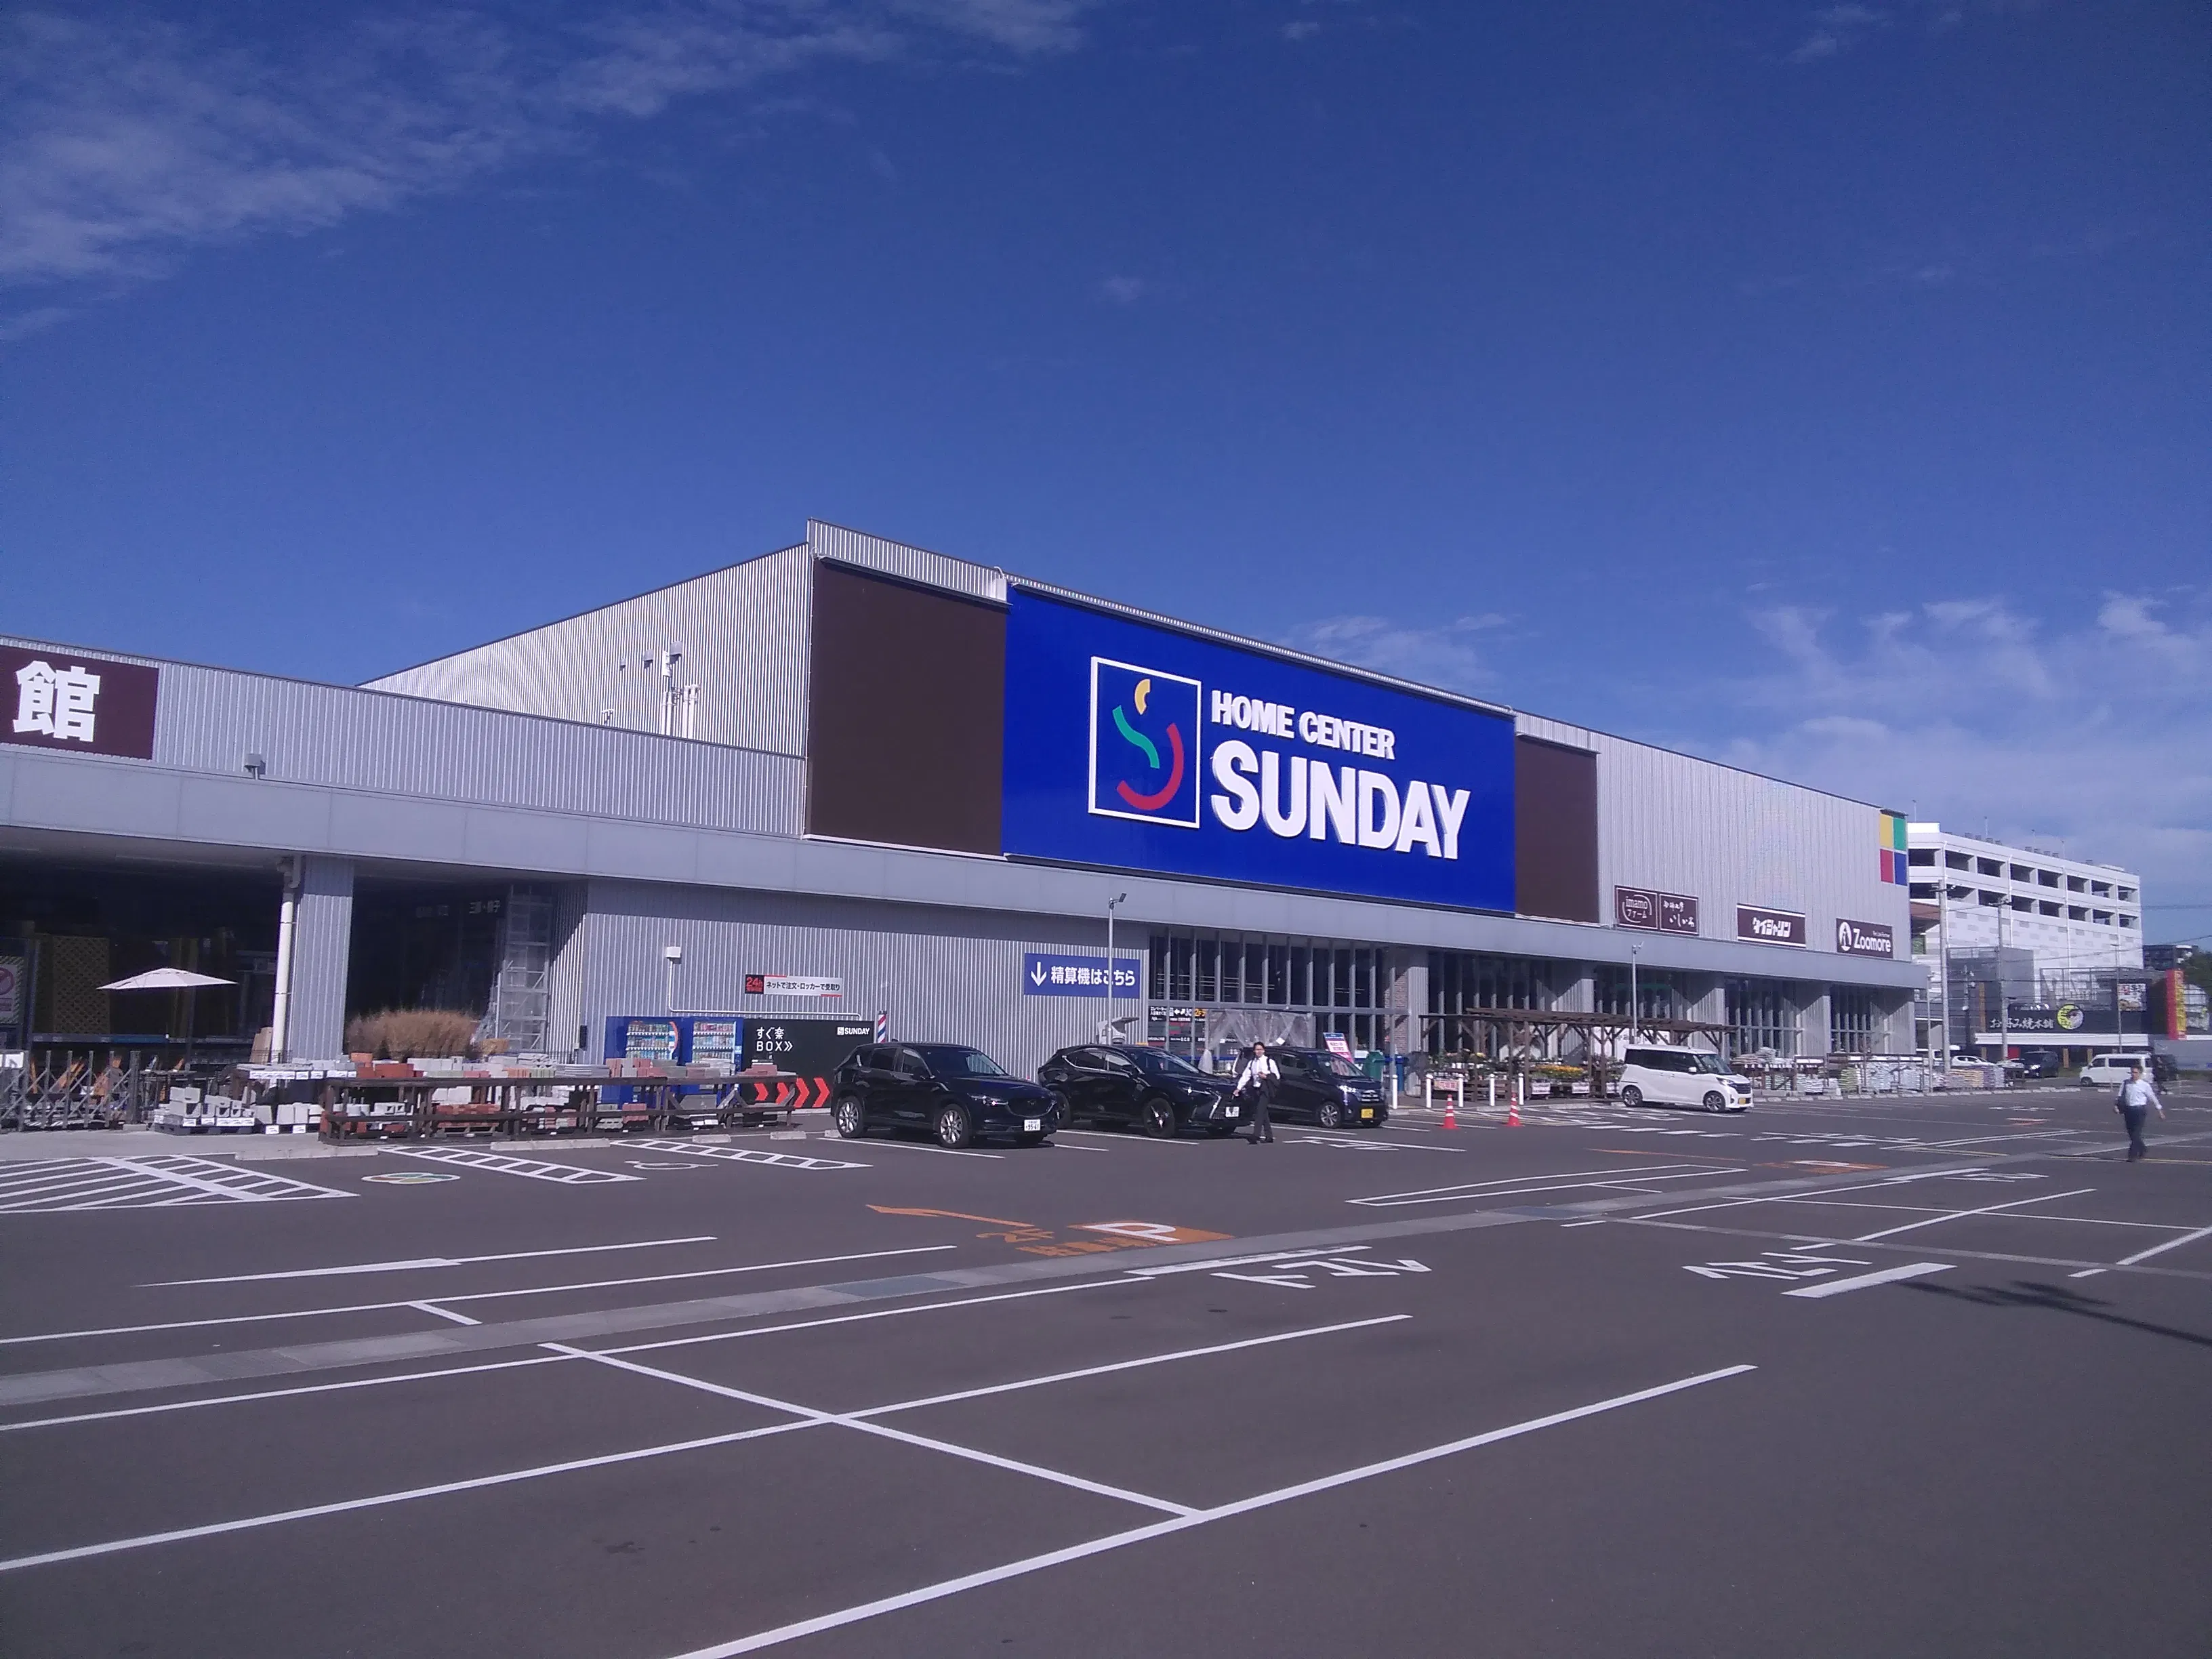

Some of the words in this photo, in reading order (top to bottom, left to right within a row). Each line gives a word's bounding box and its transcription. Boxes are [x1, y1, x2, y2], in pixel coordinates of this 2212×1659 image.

[12, 659, 101, 743] 館
[1211, 690, 1295, 739] HOME
[1298, 711, 1395, 760] CENTER
[1210, 739, 1471, 860] SUNDAY
[1853, 928, 1891, 952] Zoomore
[766, 981, 840, 991] ネットで注文・ロッカーで受取り
[1050, 966, 1135, 987] 精算機はこちら
[756, 1027, 785, 1040] すぐ楽
[756, 1041, 783, 1052] BOX
[1082, 1222, 1181, 1242] P
